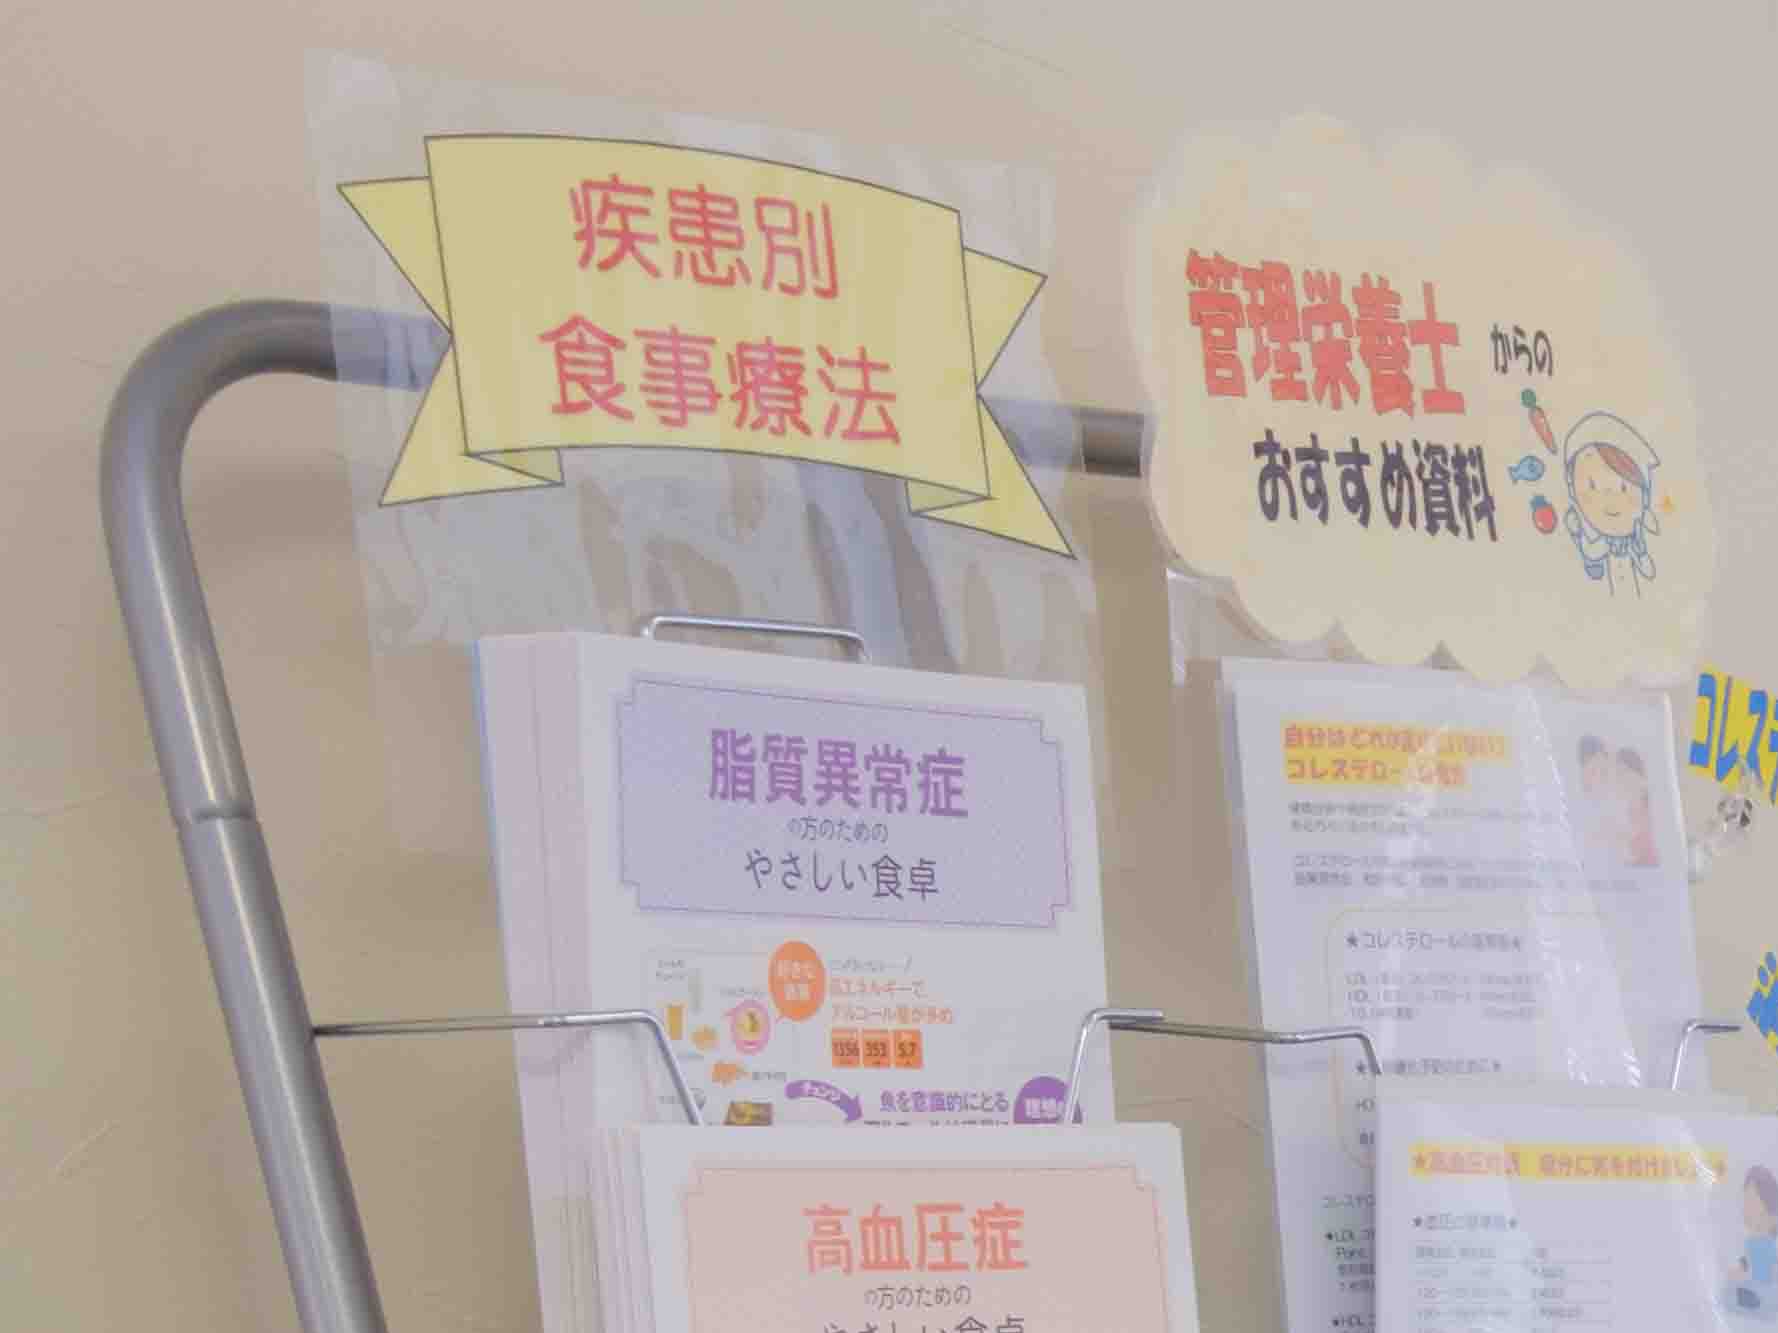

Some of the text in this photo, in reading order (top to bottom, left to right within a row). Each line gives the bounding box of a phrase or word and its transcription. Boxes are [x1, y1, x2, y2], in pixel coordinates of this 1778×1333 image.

[569, 173, 839, 300] 疾患別
[1186, 248, 1553, 418] 管理栄養士 からの
[538, 314, 902, 445] 食事療法
[1254, 430, 1498, 542] おすすめ資料
[709, 728, 969, 819] 脂質異常症
[745, 849, 939, 900] やさしい食卓
[788, 816, 889, 844] の方のための
[800, 1202, 1029, 1275] 高血圧症
[865, 1285, 971, 1309] の方のための
